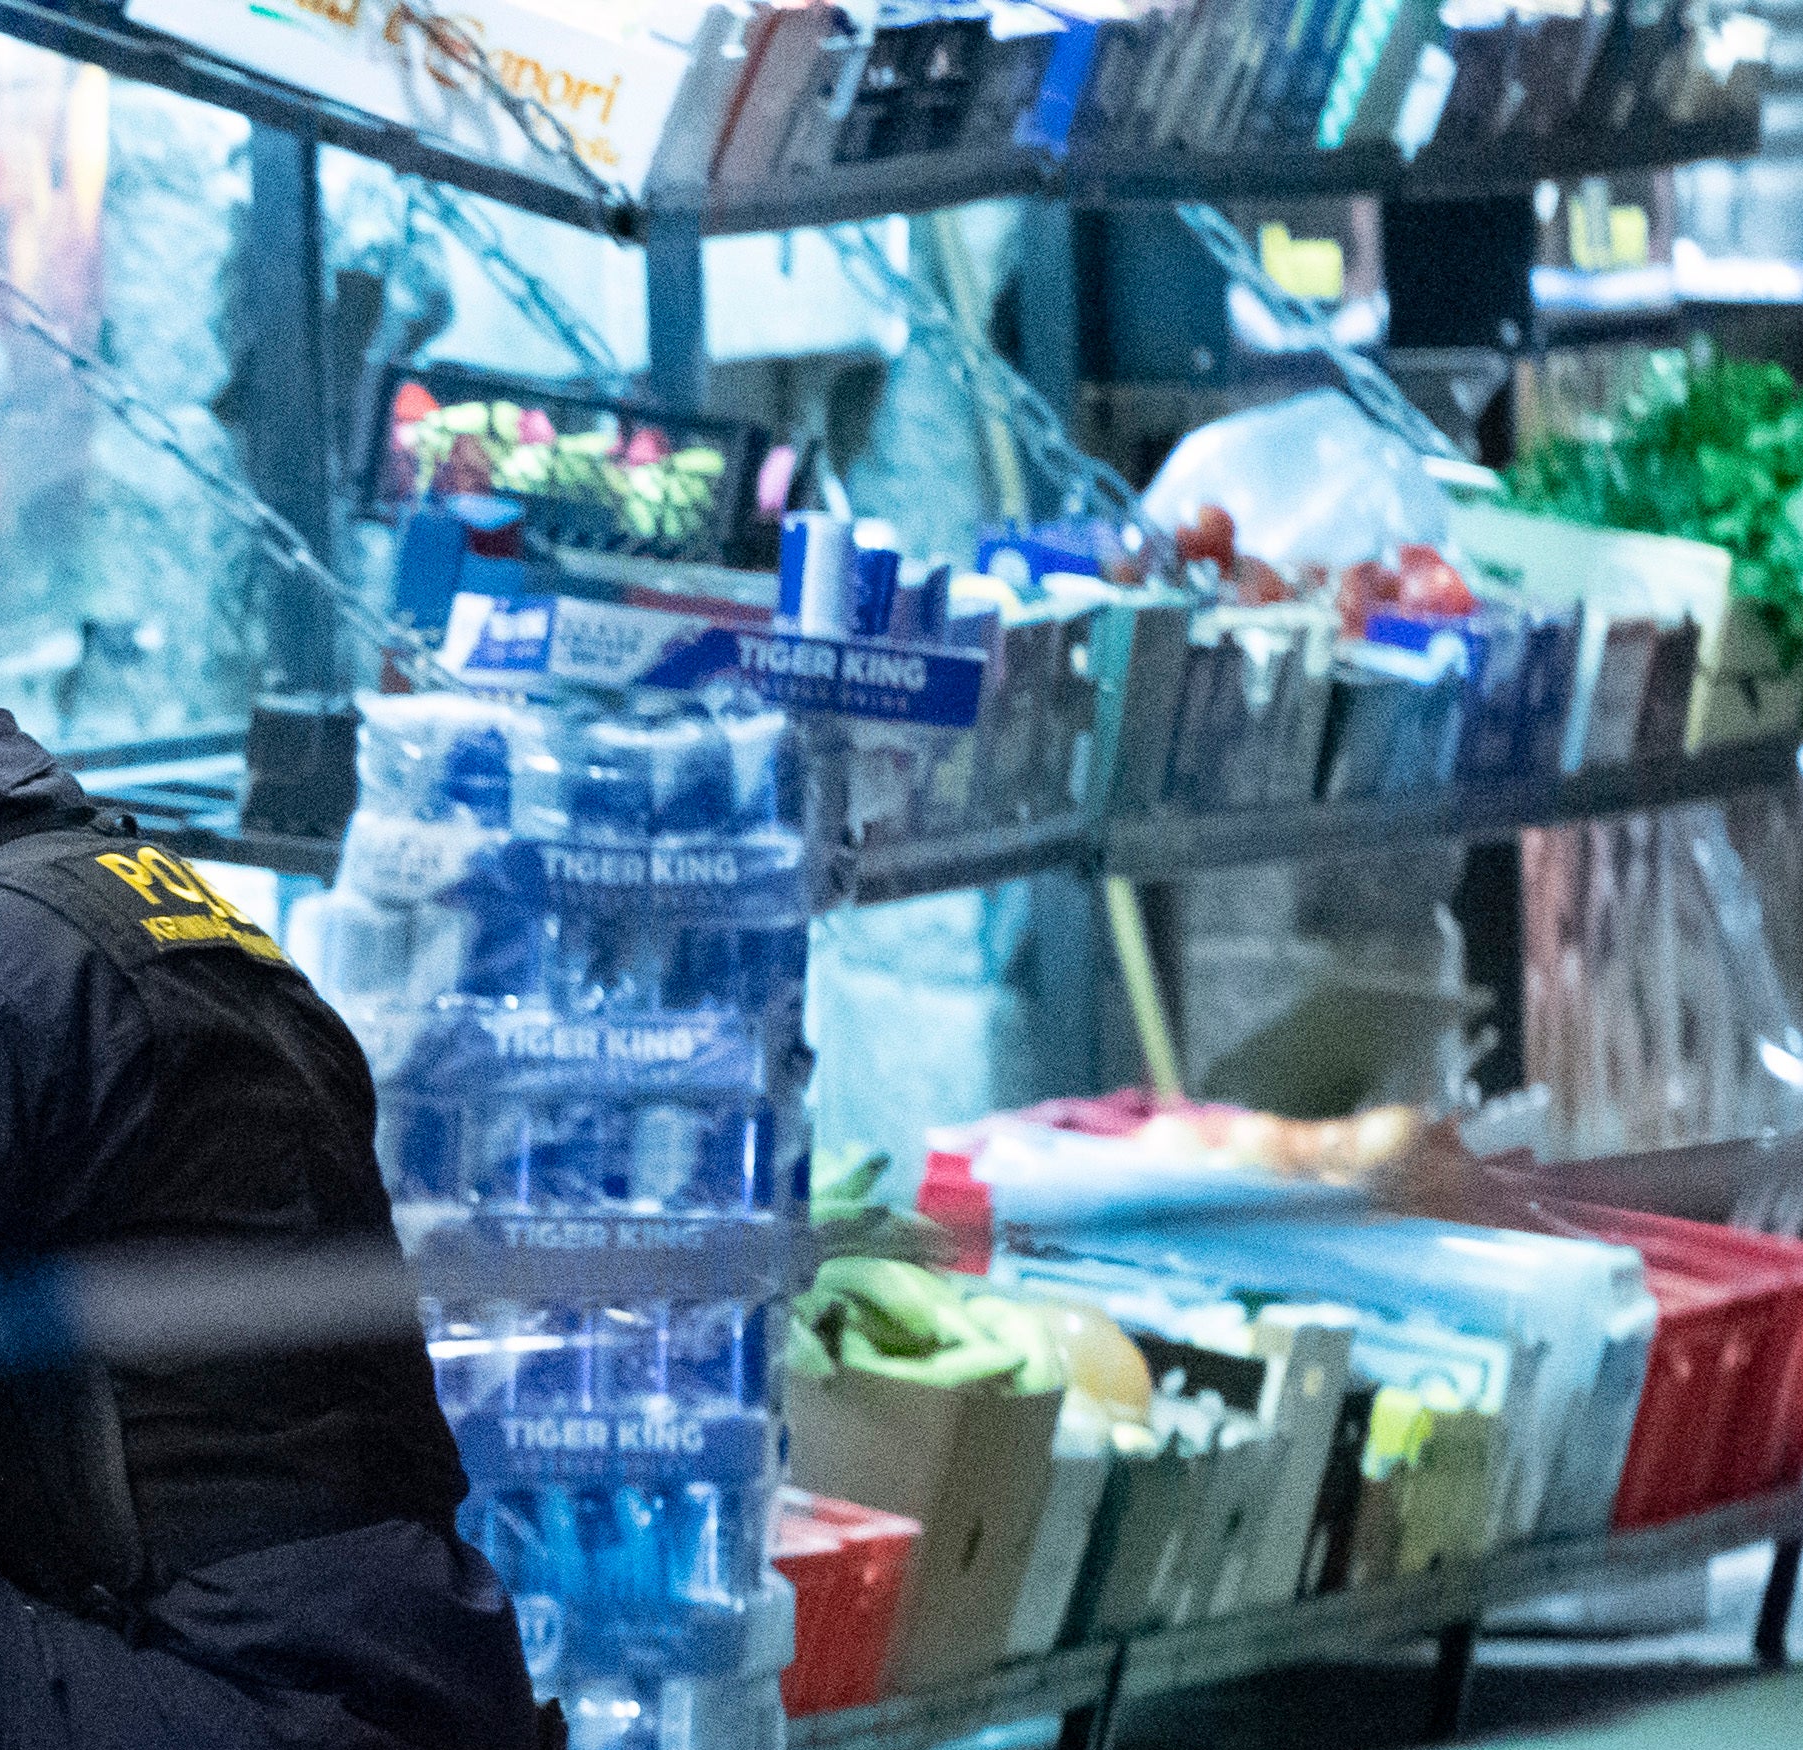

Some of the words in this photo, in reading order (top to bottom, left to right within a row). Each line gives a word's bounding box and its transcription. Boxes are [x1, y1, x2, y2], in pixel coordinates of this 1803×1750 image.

[737, 634, 837, 680] TIGER
[843, 650, 927, 692] KING
[543, 847, 645, 885] TIGER
[651, 847, 739, 886] KING
[503, 1417, 608, 1449] TIGER
[616, 1417, 705, 1451] KING
